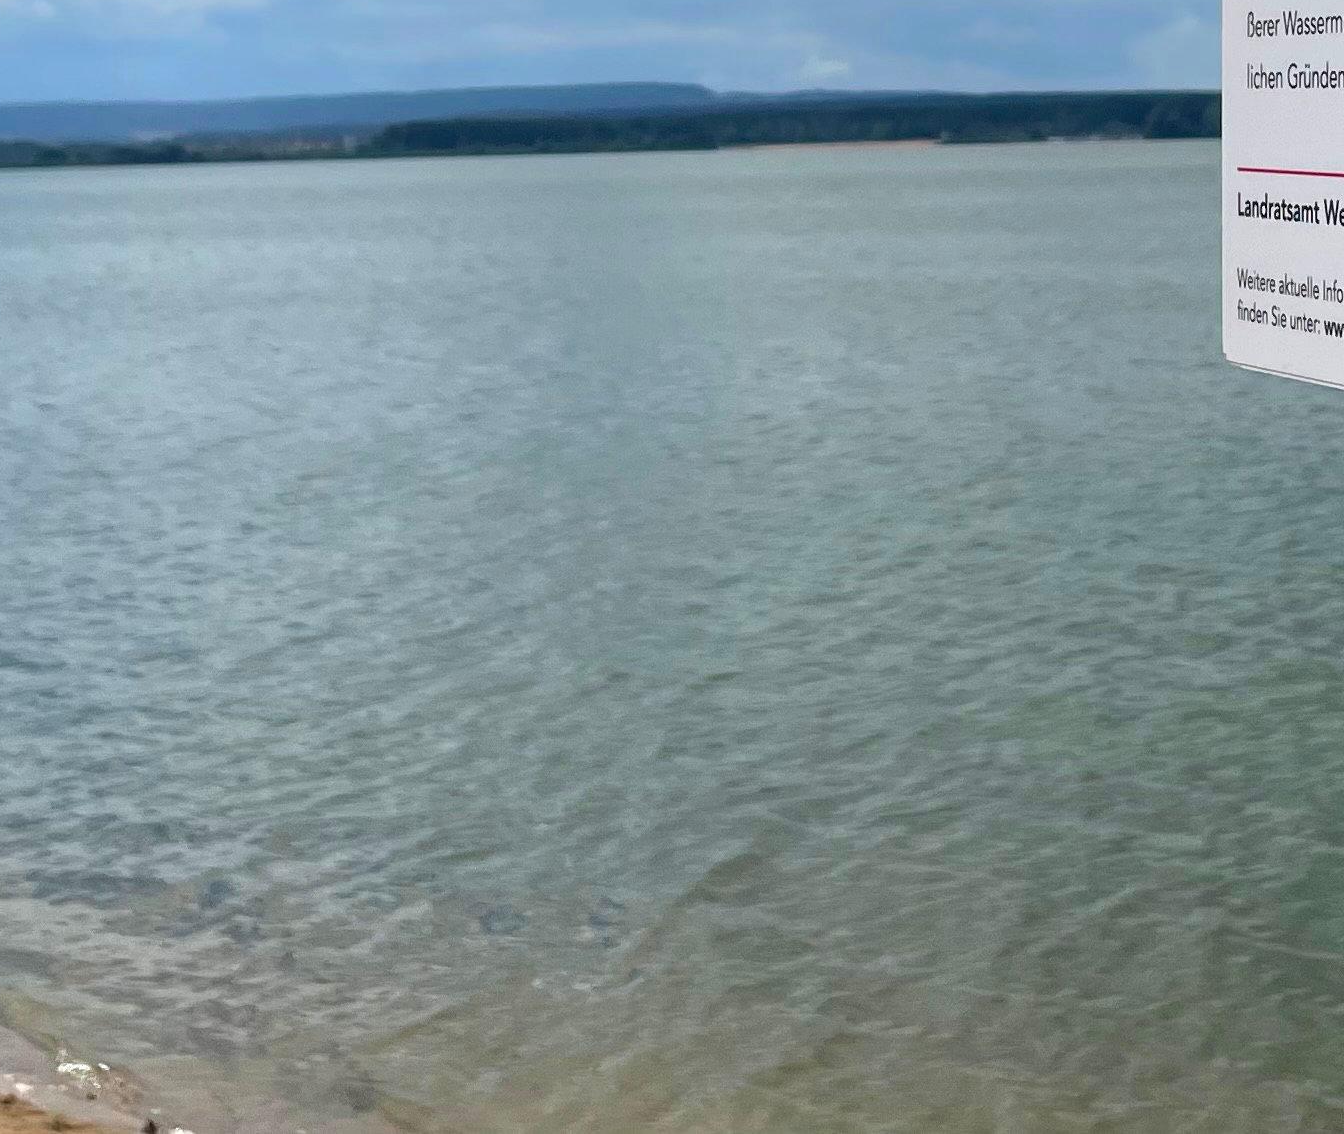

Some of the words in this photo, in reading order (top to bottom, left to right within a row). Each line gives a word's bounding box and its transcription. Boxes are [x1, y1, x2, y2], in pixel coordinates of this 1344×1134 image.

[1247, 11, 1280, 38] ßerer
[1247, 63, 1283, 89] lichen
[1287, 61, 1344, 89] Gründen
[1237, 192, 1320, 224] Landratsamt
[1236, 267, 1275, 293] Weitere
[1278, 273, 1319, 300] aktuelle
[1237, 299, 1268, 325] finden
[1271, 305, 1287, 328] Sie
[1289, 313, 1320, 335] unter:
